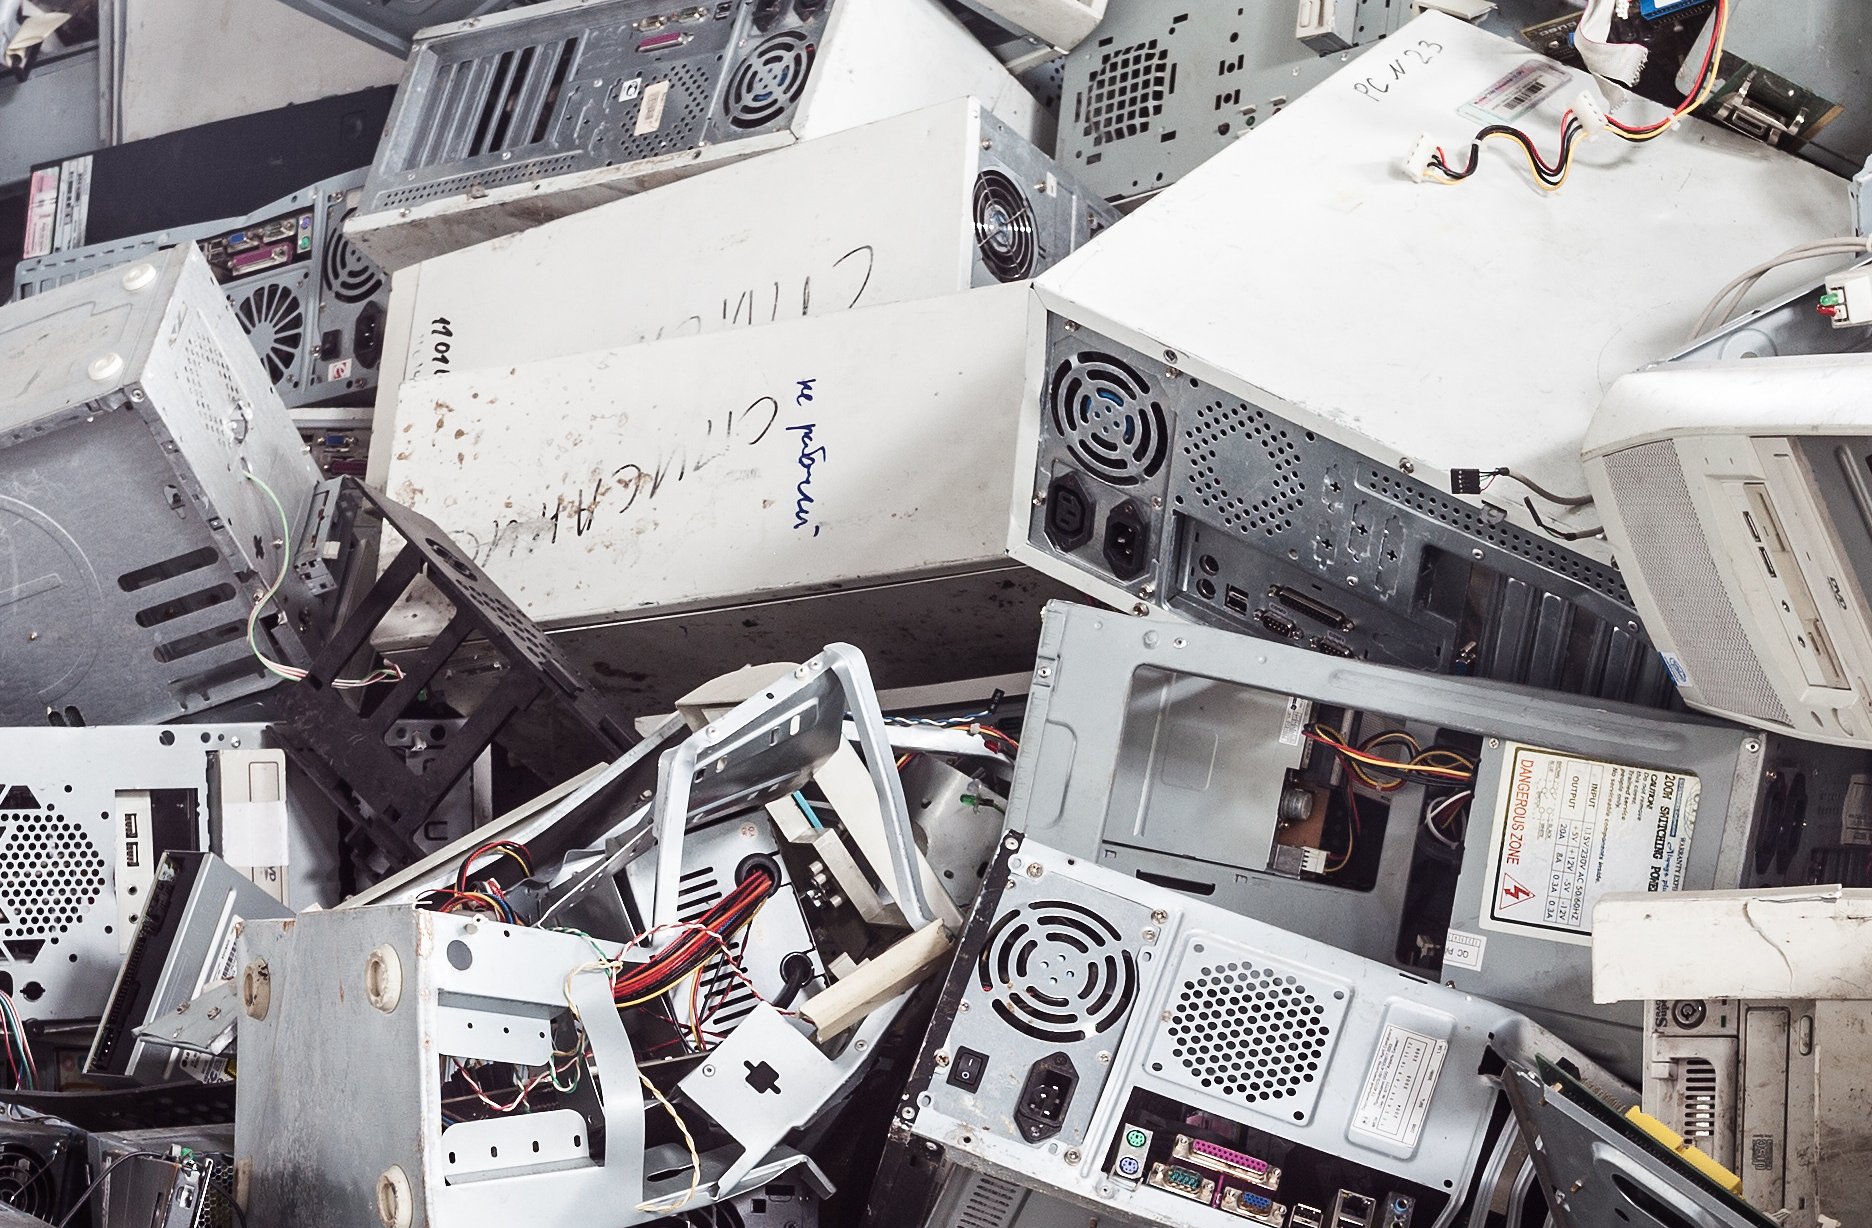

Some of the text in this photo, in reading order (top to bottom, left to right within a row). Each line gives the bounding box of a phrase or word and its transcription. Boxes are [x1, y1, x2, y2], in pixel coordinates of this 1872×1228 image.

[1404, 40, 1442, 64] 23
[1567, 775, 1579, 809] OUTPUT
[1587, 782, 1598, 808] INPUT
[1506, 758, 1534, 865] DANGEROUS ZONE
[1652, 805, 1669, 860] SWITCHING
[1576, 871, 1584, 883] AC
